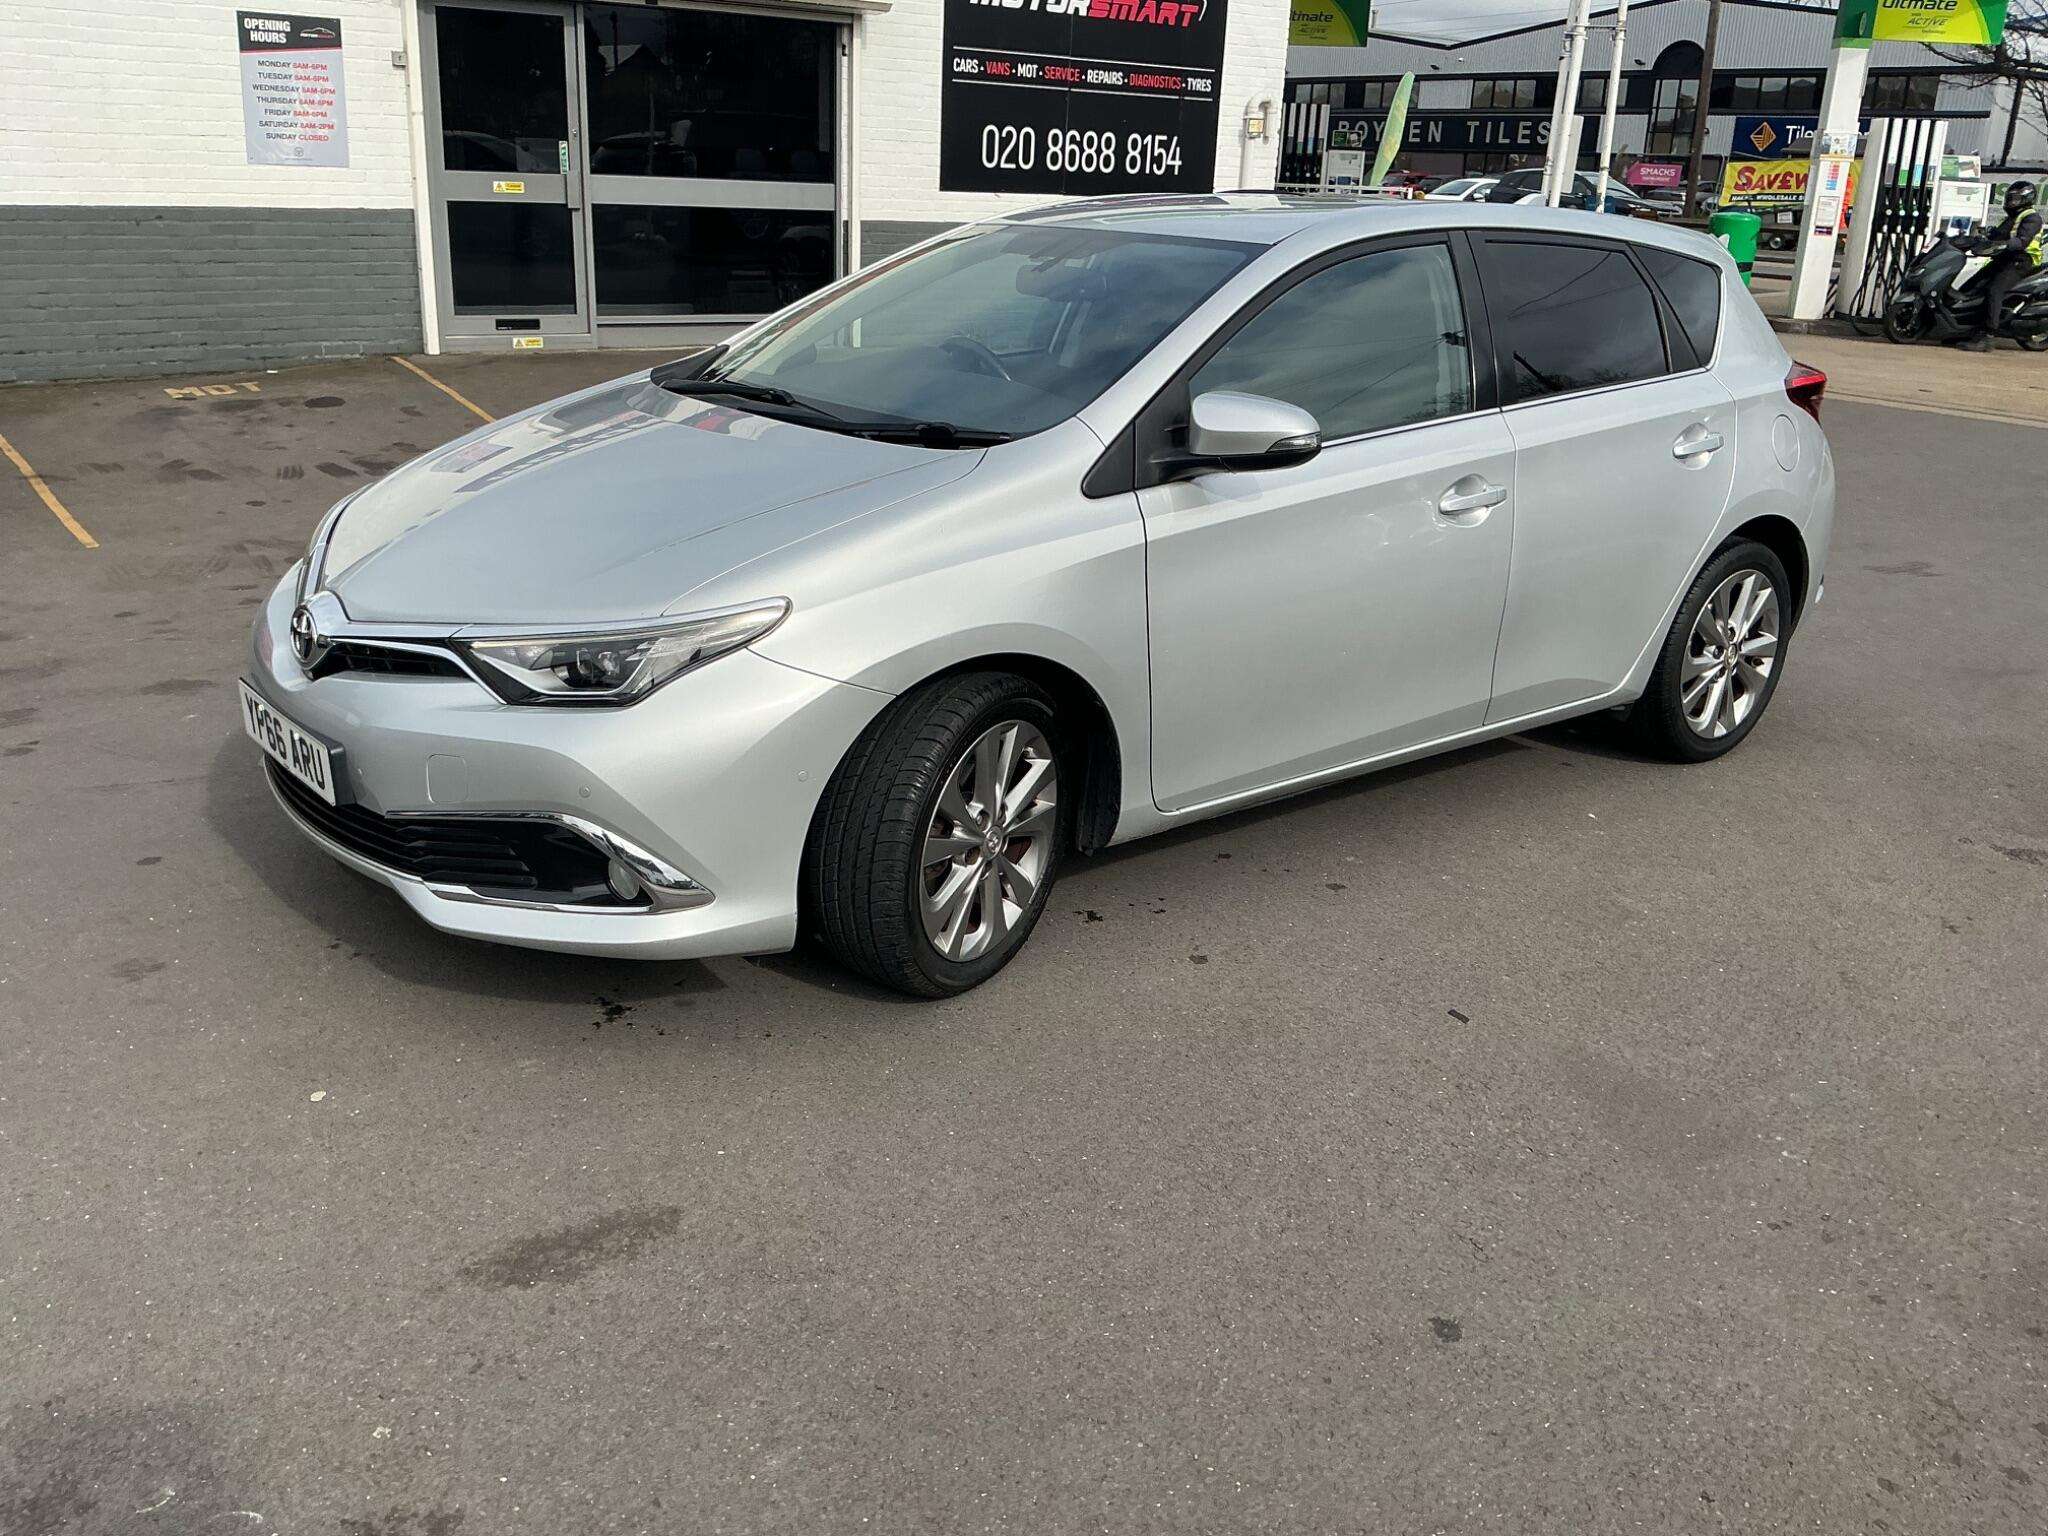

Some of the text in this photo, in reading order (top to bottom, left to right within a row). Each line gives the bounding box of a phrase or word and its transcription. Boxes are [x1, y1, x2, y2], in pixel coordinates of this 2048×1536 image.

[244, 18, 290, 32] OPENING
[1907, 17, 1948, 26] ACTIVE
[250, 30, 286, 44] HOURS
[258, 60, 290, 68] MONDAY
[258, 72, 292, 80] TUESDAY
[953, 57, 1212, 92] CARS VANS MOT SERVICE REPAIRS DIAGNOSTICS TYRES
[252, 84, 300, 92] WEDNESDAY
[256, 96, 297, 104] THURSDAY
[264, 108, 291, 116] FRIDAY
[259, 120, 298, 128] SATURDAY
[1338, 120, 1551, 144] OYEN TILES
[266, 132, 329, 142] SUNDAY CLOSED
[982, 124, 1182, 176] 020 8688 8154
[1640, 167, 1676, 176] SMACKS
[163, 381, 261, 399] MOT
[244, 692, 325, 790] YP66 ARU
